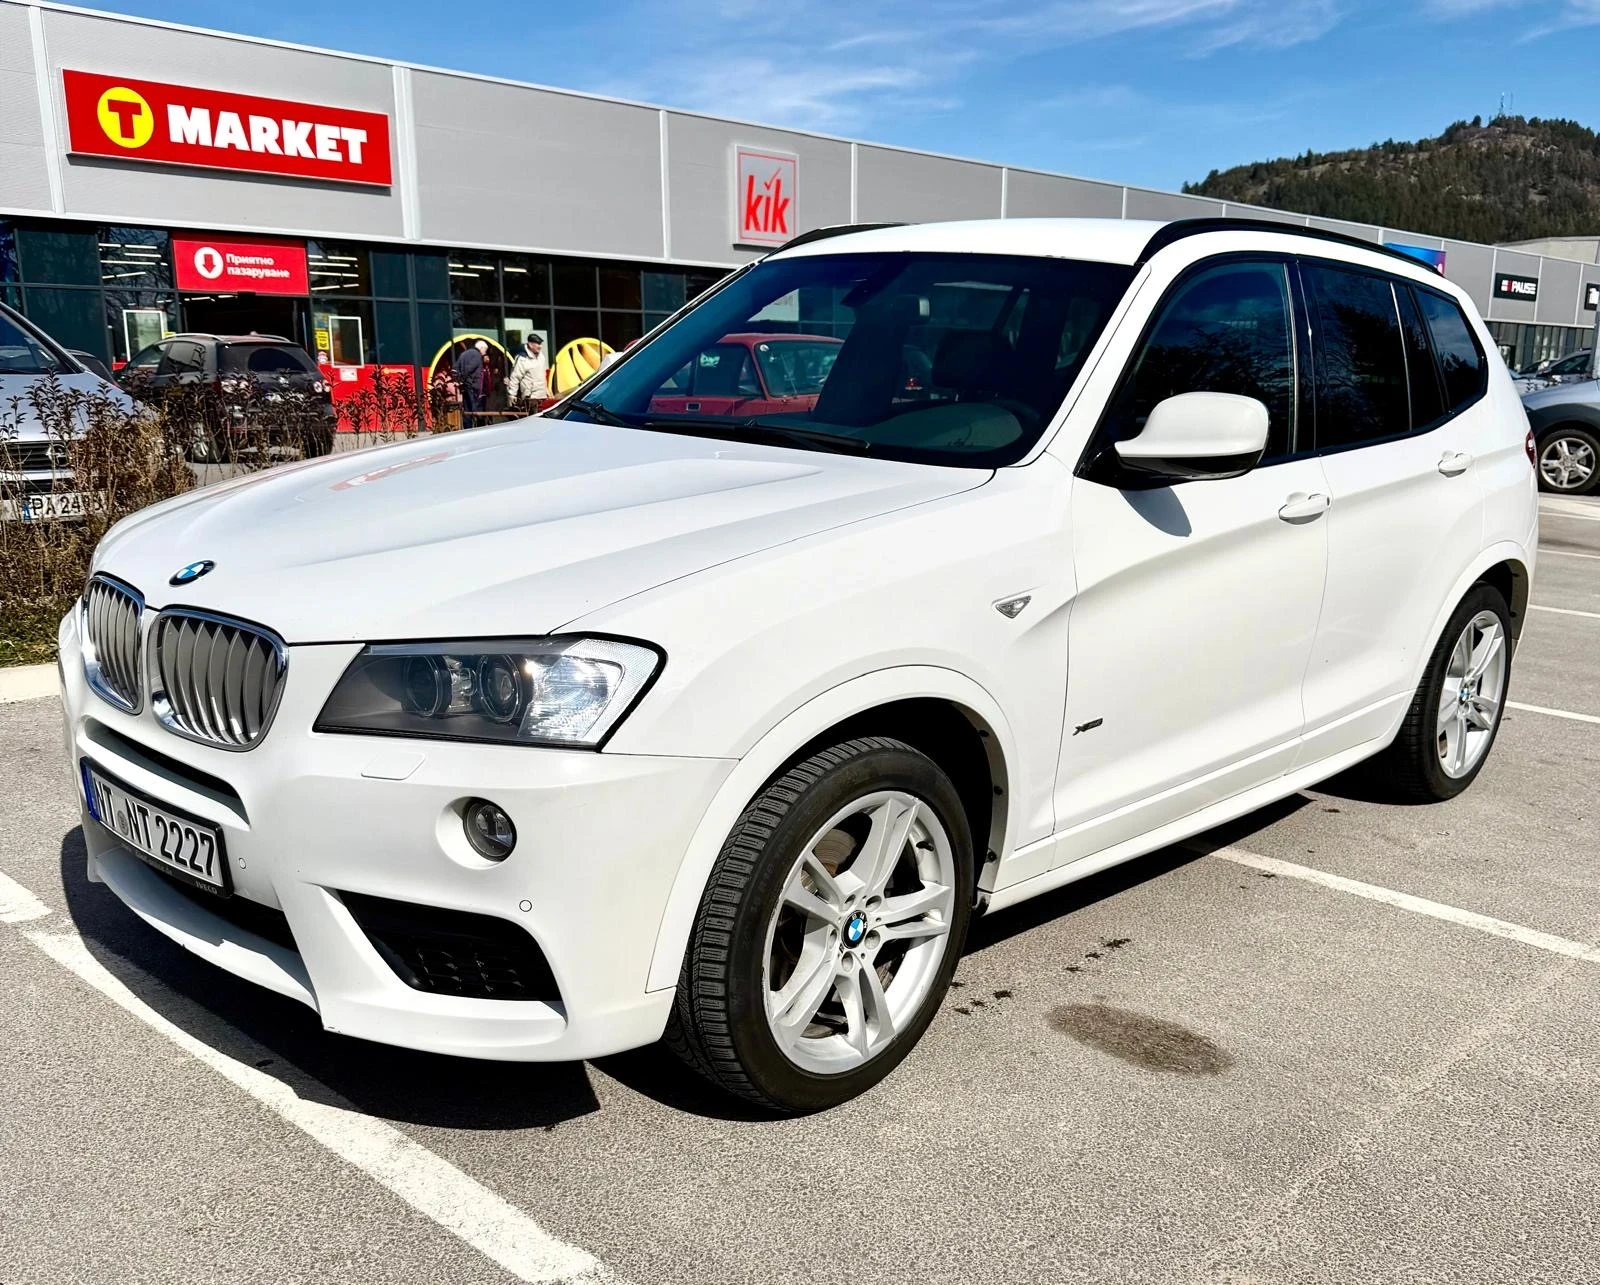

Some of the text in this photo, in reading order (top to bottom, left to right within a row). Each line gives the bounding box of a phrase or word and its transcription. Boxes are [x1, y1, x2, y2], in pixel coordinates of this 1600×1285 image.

[107, 98, 367, 165] T MARKET
[745, 168, 790, 234] kik
[225, 253, 275, 266] Приятно
[227, 266, 291, 279] пазаруване
[1511, 280, 1537, 295] PAUSE
[125, 798, 152, 849] NT
[155, 814, 214, 877] 2227
